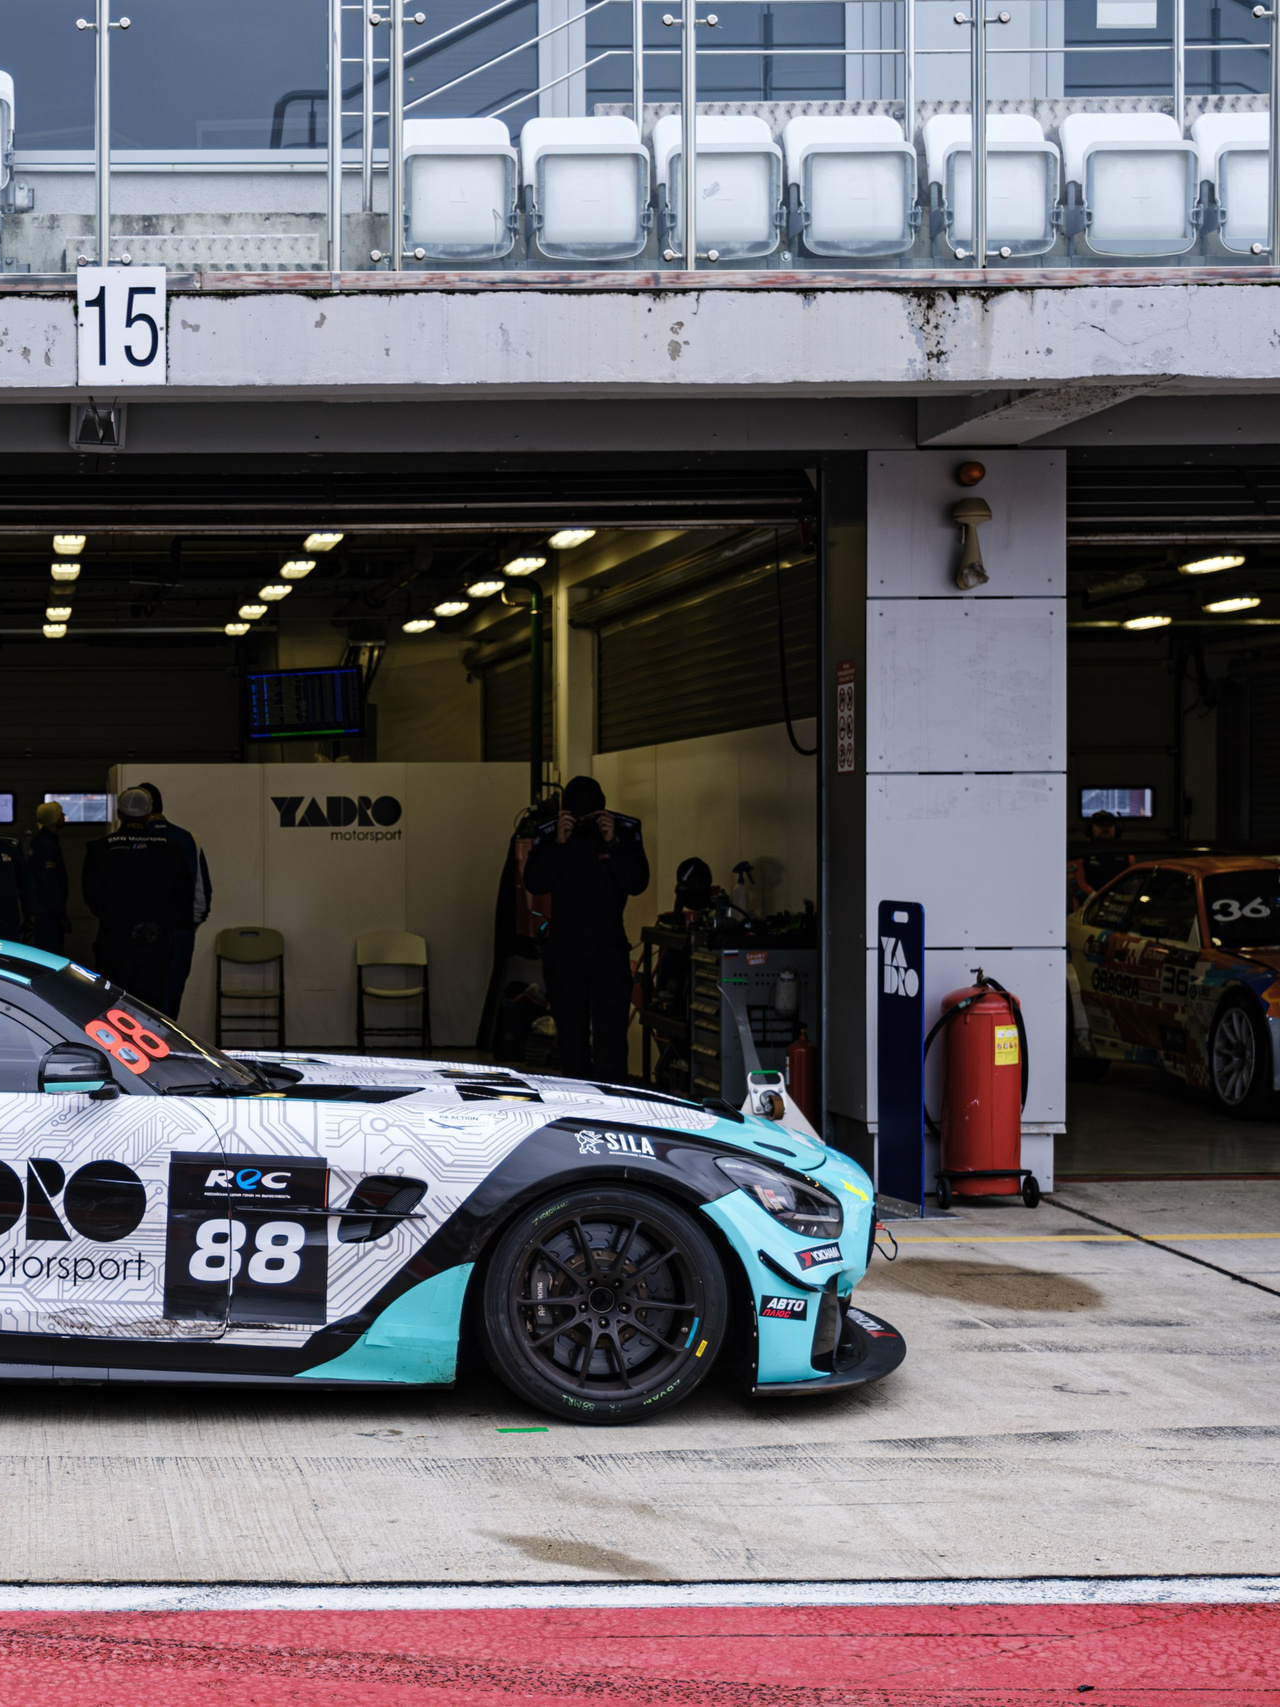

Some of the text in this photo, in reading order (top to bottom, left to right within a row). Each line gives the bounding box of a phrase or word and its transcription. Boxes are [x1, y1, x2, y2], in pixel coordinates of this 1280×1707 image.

[84, 285, 159, 367] 15
[270, 795, 402, 828] YADRO
[330, 828, 402, 843] motorsport
[1211, 896, 1271, 922] 36
[1163, 966, 1189, 996] 36
[84, 1008, 171, 1075] 88
[604, 1132, 655, 1155] SILA
[188, 1218, 306, 1284] 88
[762, 1308, 791, 1318] ПЛЮС
[766, 1297, 805, 1311] АВТО
